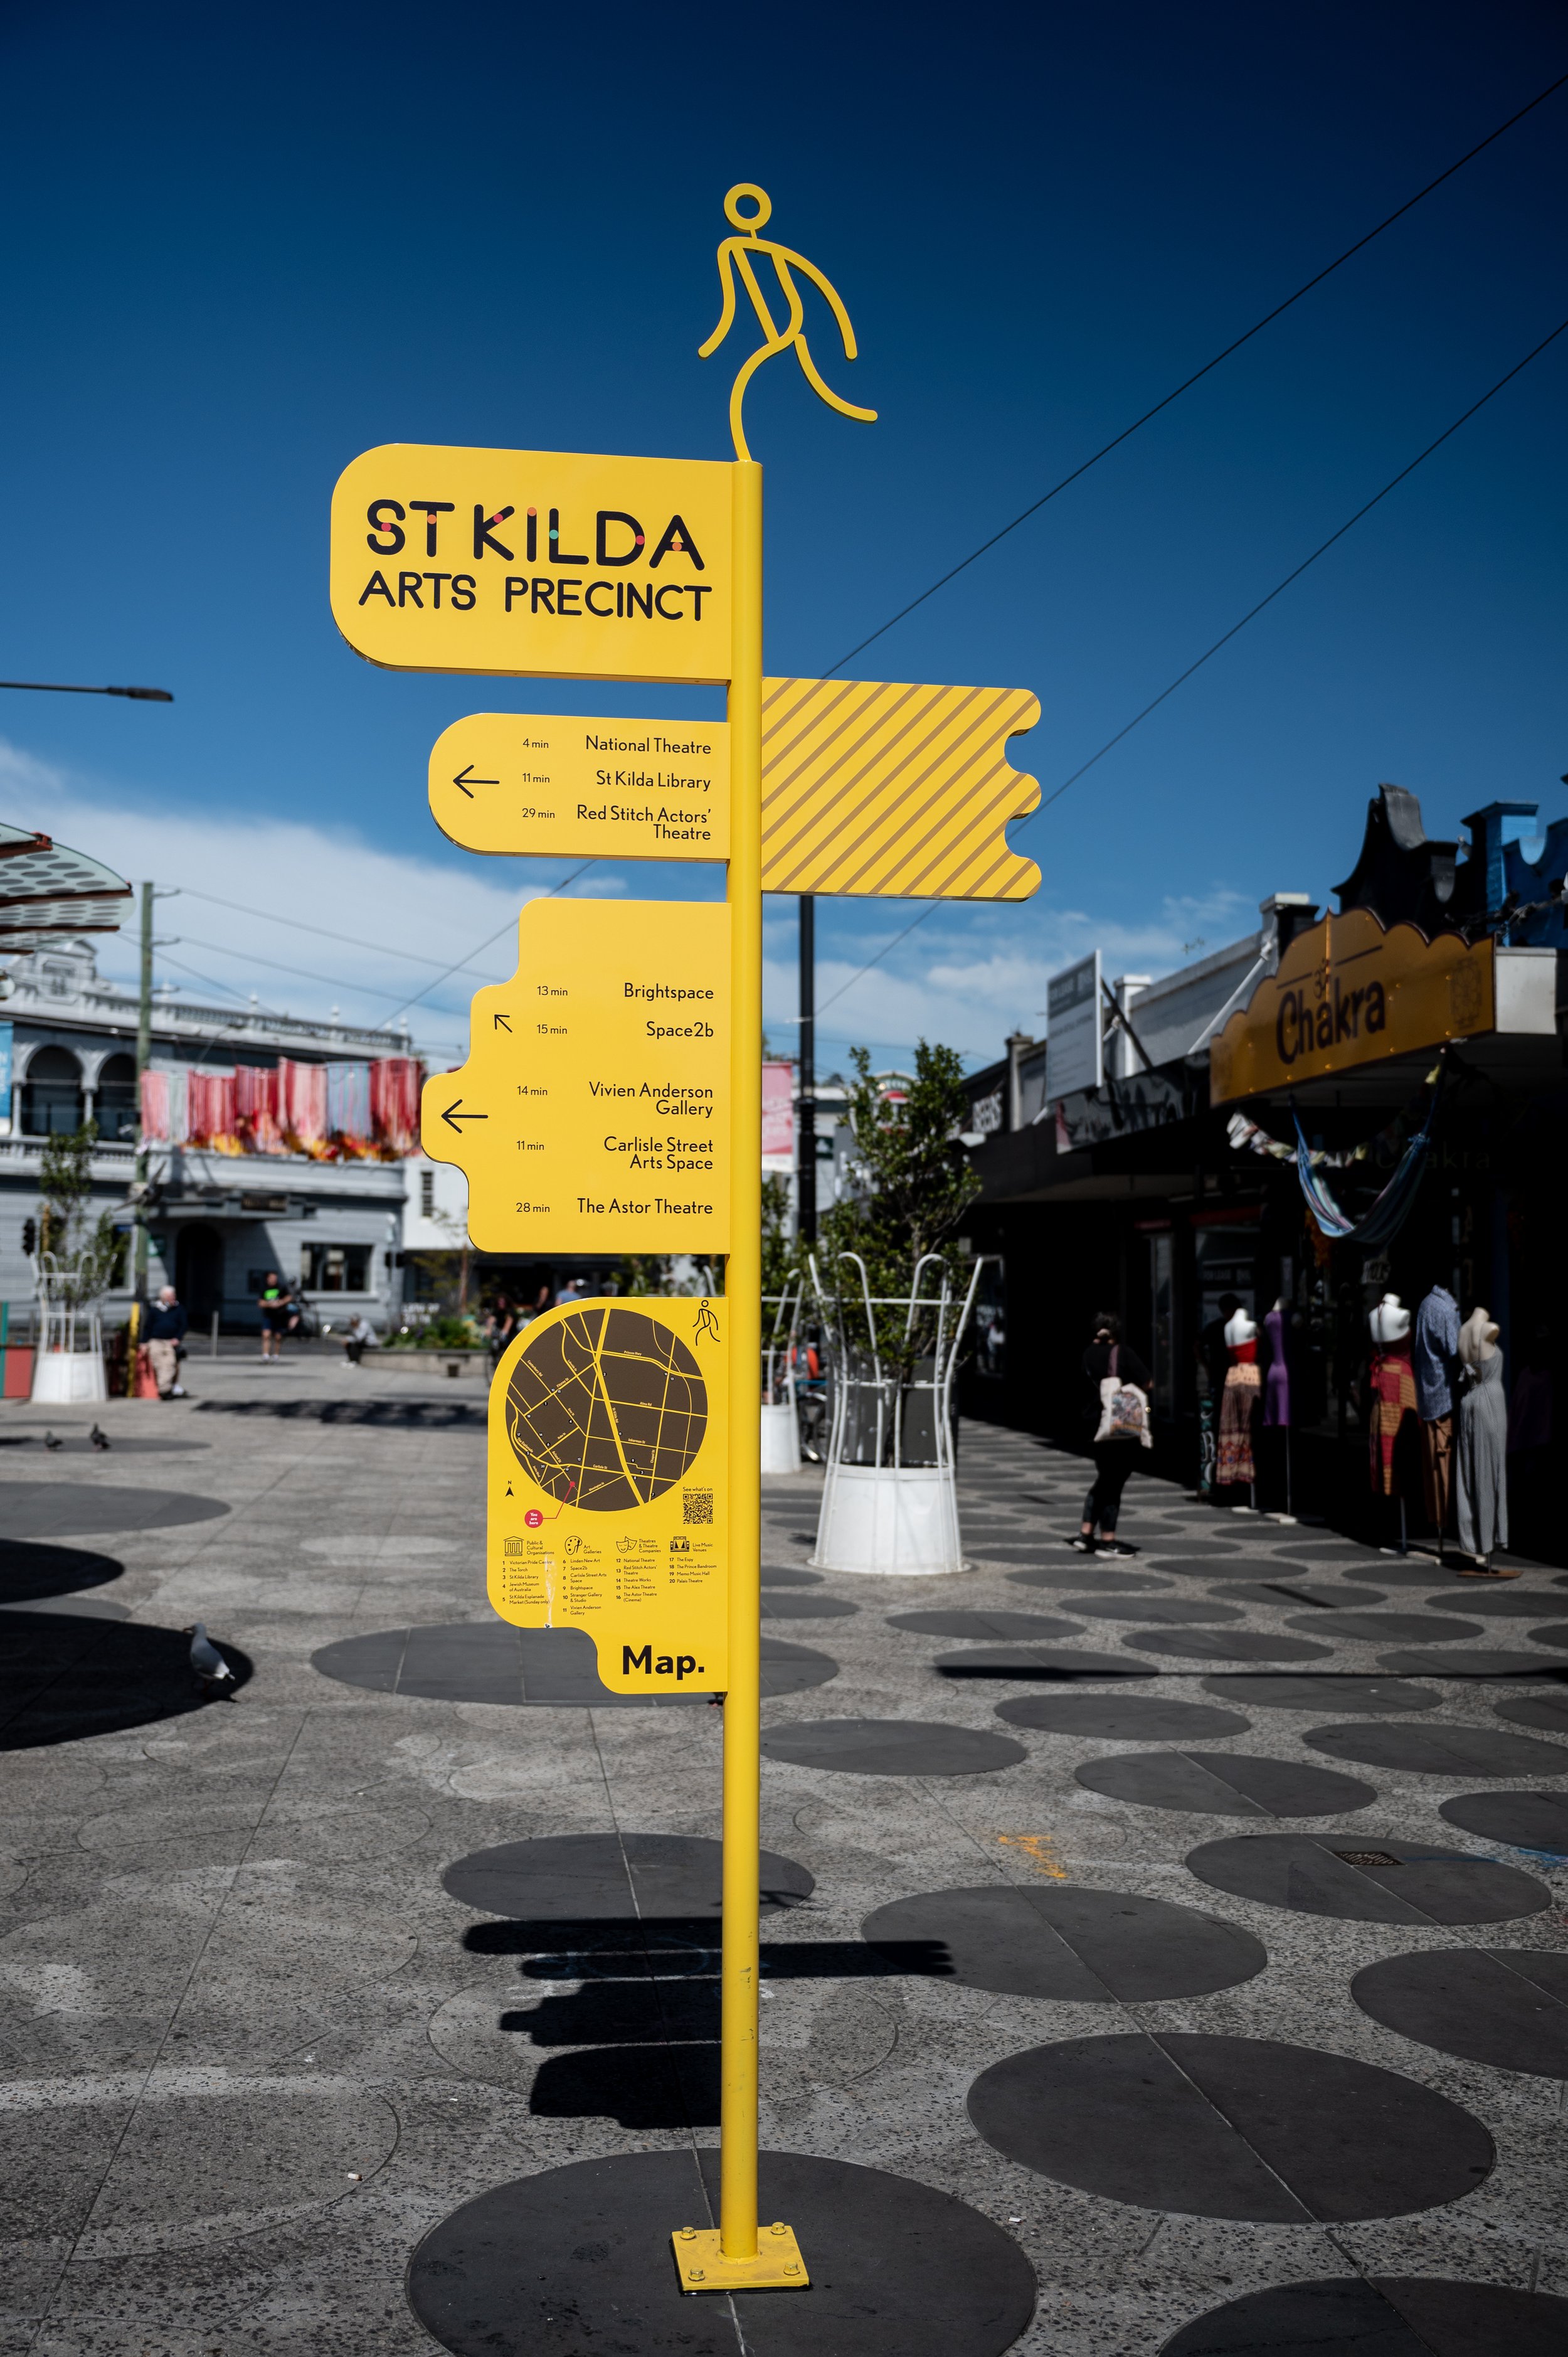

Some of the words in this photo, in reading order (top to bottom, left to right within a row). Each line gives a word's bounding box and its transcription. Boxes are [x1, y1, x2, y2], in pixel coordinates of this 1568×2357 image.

[367, 499, 455, 557] ST
[474, 504, 705, 571] KILDA
[358, 570, 476, 610] ARTS
[505, 577, 712, 621] PRECINCT
[522, 738, 529, 747] 4
[586, 735, 649, 752] National
[654, 738, 711, 754] Theatre
[522, 773, 530, 782] 11
[533, 775, 549, 783] min
[596, 770, 611, 785] St
[616, 771, 654, 787] Kilda
[658, 772, 711, 792] Library
[522, 808, 536, 817] 29
[538, 810, 555, 818] min
[578, 804, 606, 820] Red
[611, 806, 653, 821] Stitch
[657, 807, 711, 823] Actors'
[653, 824, 711, 840] Theatre
[537, 986, 548, 996] 13
[551, 987, 568, 996] min
[625, 982, 714, 1002] Brightspace
[1276, 977, 1385, 1064] Chakra
[537, 1024, 548, 1034] 15
[550, 1026, 567, 1034] min
[647, 1021, 714, 1040] Space2b
[517, 1086, 528, 1095] 14
[531, 1087, 548, 1095] min
[589, 1082, 635, 1097] Vivien
[639, 1082, 712, 1098] Anderson
[656, 1099, 713, 1119] Gallery
[517, 1141, 524, 1150] 11
[527, 1142, 544, 1150] min
[604, 1136, 663, 1152] Carlisle
[667, 1137, 713, 1152] Street
[630, 1154, 662, 1169] Arts
[667, 1154, 713, 1173] Space
[516, 1203, 530, 1212] 28
[533, 1204, 550, 1212] min
[577, 1198, 605, 1213] The
[608, 1198, 651, 1213] Astor
[655, 1198, 712, 1214] Theatre
[623, 1645, 704, 1680] Map.
